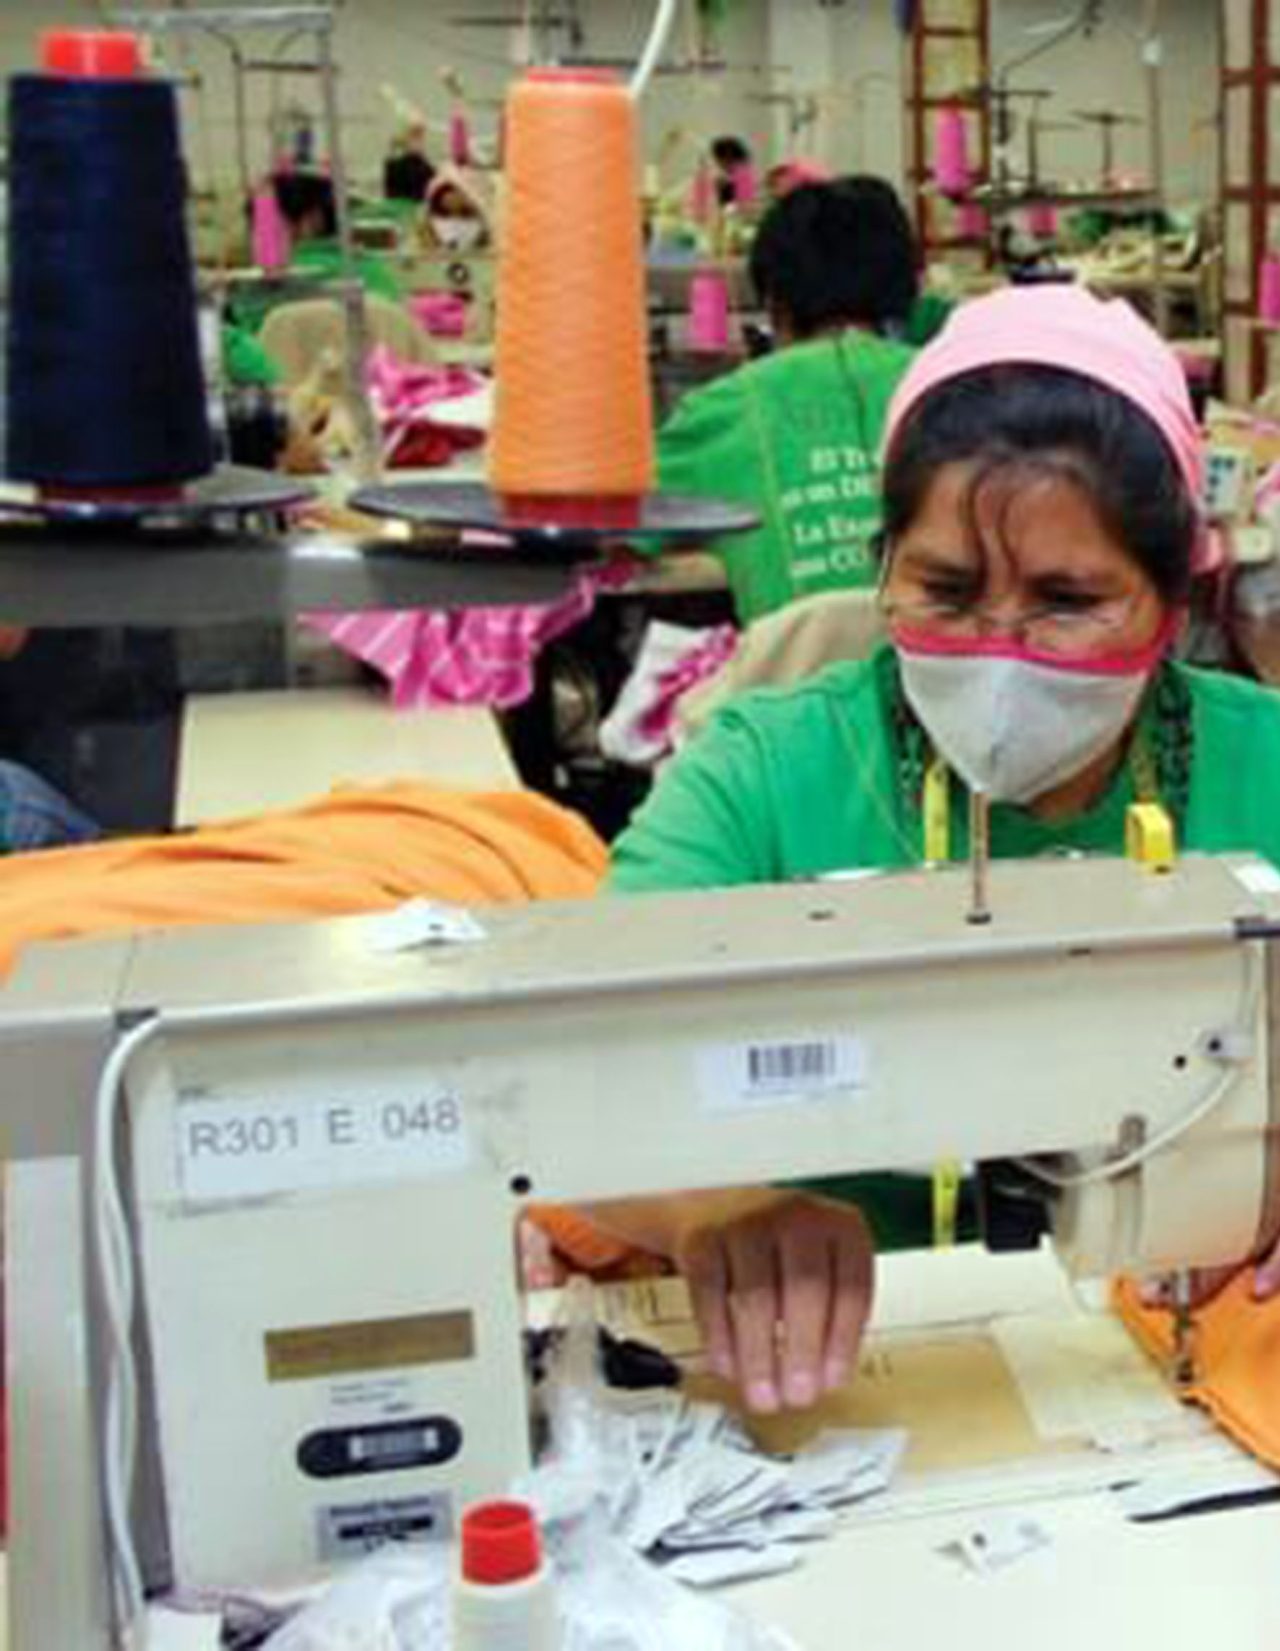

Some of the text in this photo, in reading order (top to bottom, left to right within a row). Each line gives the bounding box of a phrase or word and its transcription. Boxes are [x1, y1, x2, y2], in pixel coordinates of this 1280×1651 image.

[793, 523, 825, 545] La
[188, 1097, 461, 1157] R301 E 048
